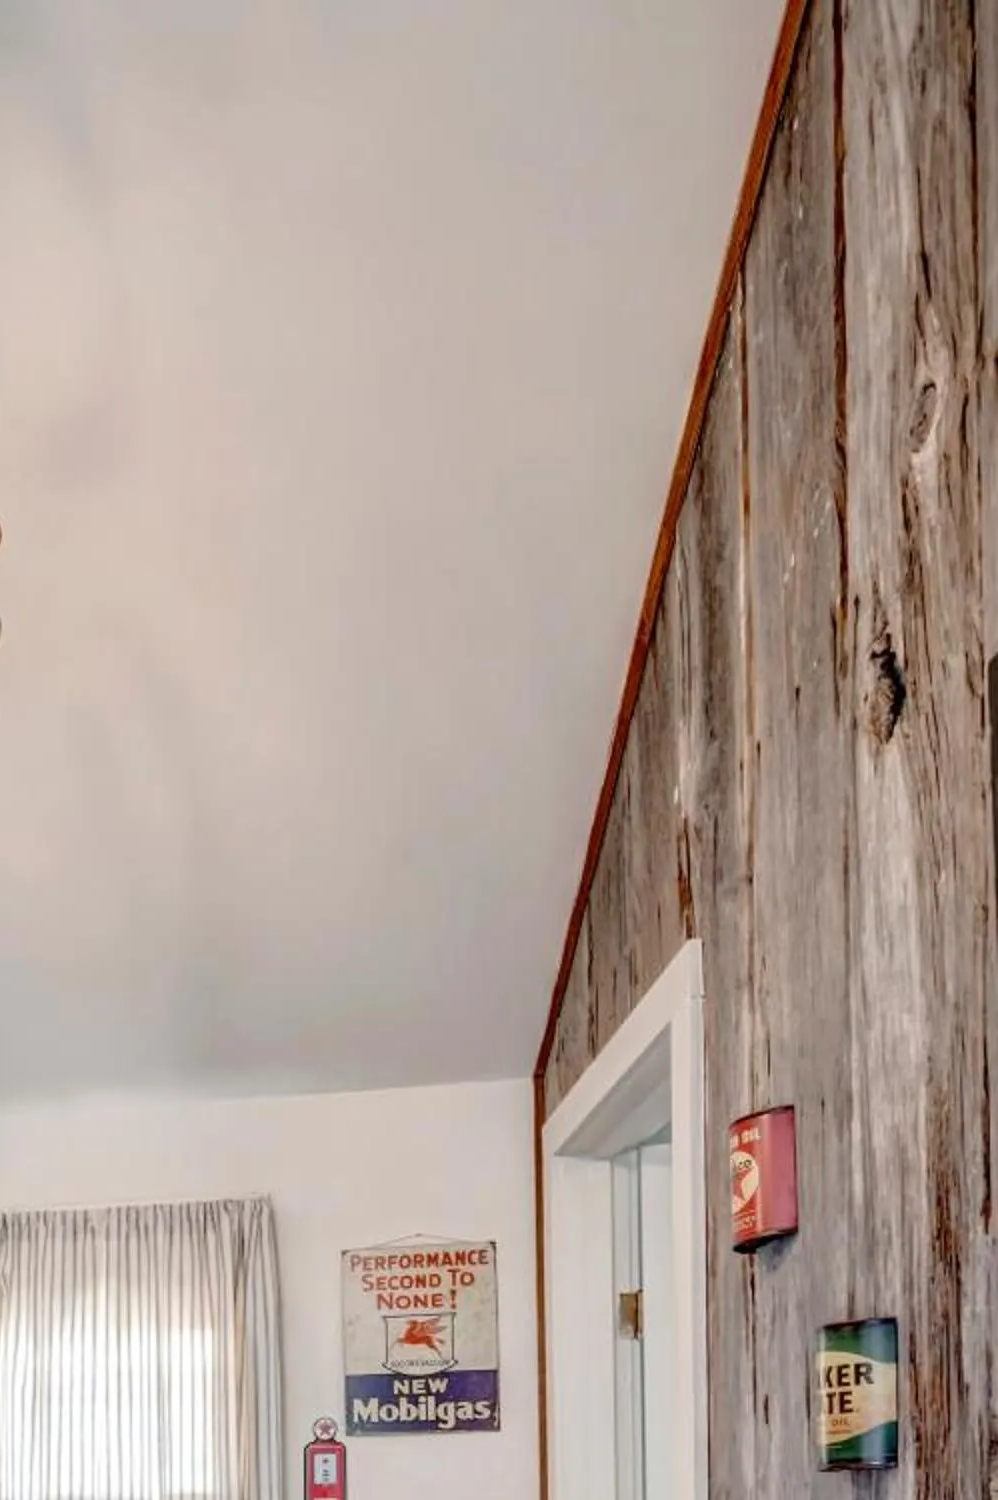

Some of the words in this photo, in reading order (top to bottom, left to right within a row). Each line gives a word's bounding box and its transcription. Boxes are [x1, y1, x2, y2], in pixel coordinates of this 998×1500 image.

[350, 1249, 490, 1273] PERFORMANCE
[361, 1271, 441, 1293] SECOND
[447, 1268, 475, 1287] TO
[376, 1289, 458, 1311] NONE!
[393, 1377, 449, 1396] NEW
[352, 1397, 491, 1430] Mobilgas
